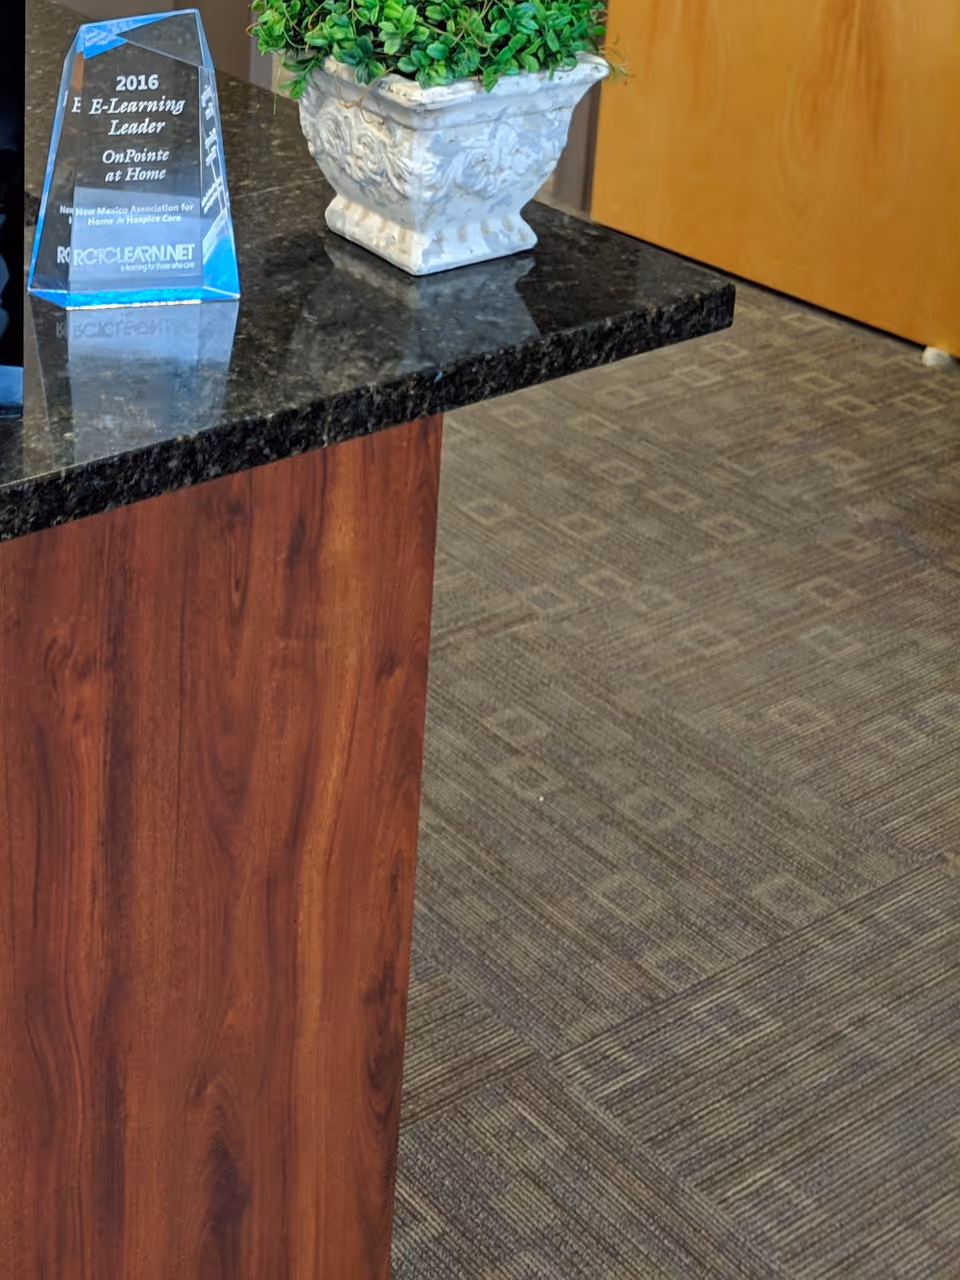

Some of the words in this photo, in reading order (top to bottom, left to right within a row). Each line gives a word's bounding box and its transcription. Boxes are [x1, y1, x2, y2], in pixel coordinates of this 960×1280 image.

[116, 74, 159, 91] 2016
[89, 95, 186, 115] E-Learning
[107, 117, 166, 136] Leader
[102, 148, 170, 164] OnPointe
[104, 170, 122, 183] at
[125, 166, 167, 181] Home
[182, 203, 195, 212] for
[126, 215, 160, 225] Hospice
